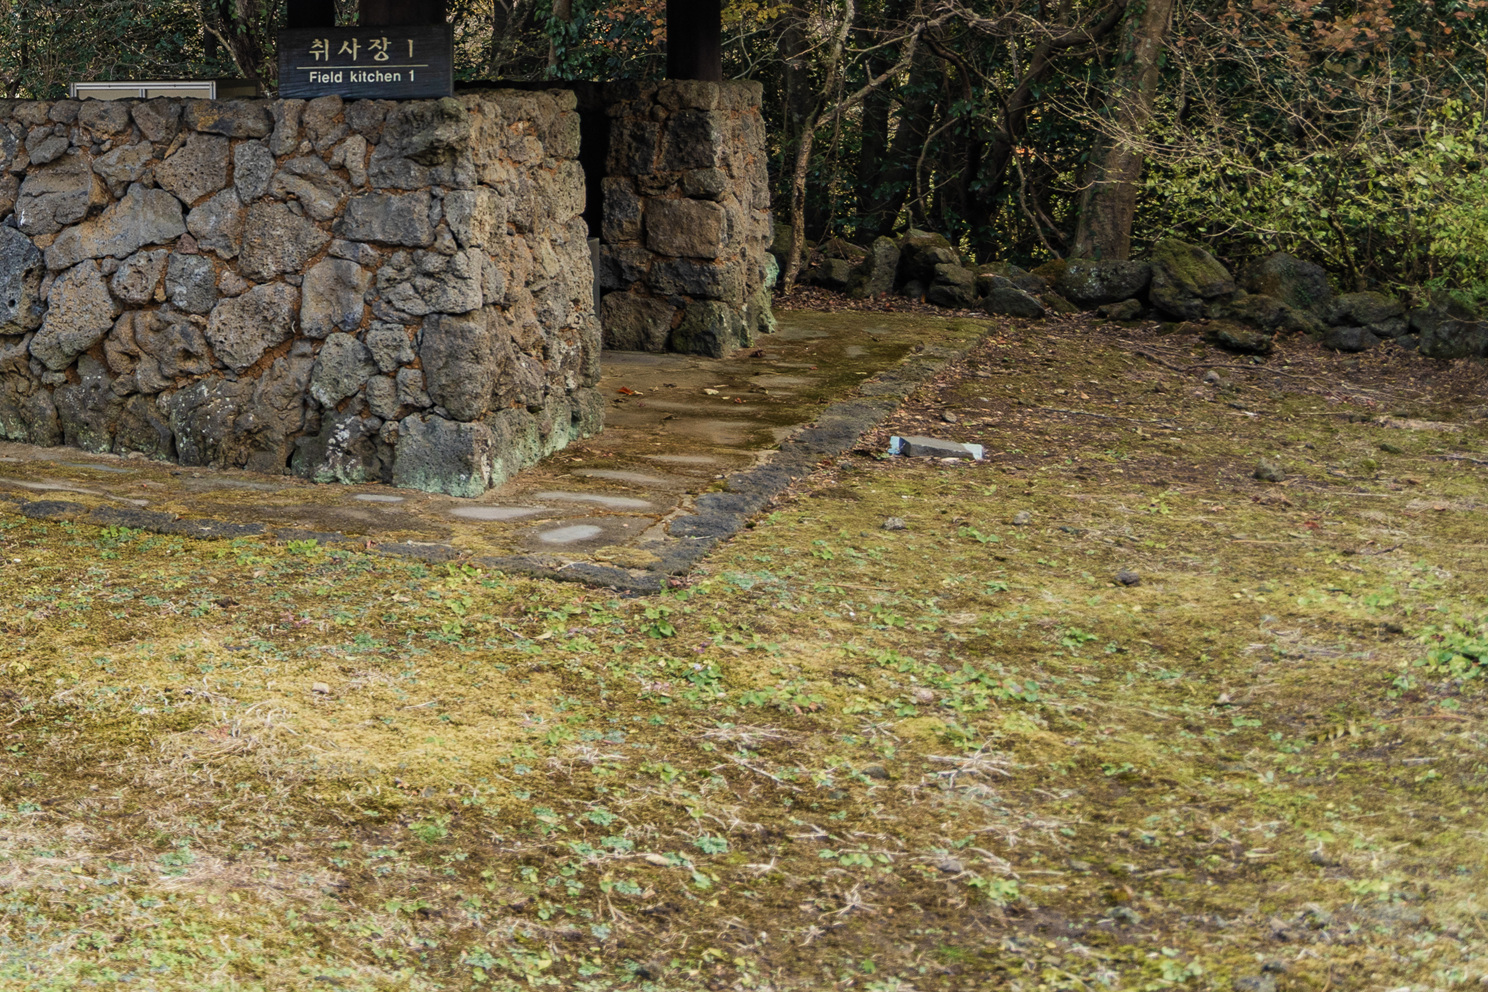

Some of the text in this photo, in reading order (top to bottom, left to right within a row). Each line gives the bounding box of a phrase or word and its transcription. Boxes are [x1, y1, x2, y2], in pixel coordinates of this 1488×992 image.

[308, 36, 392, 62] 취사장
[309, 70, 415, 84] Field kitchen 1
